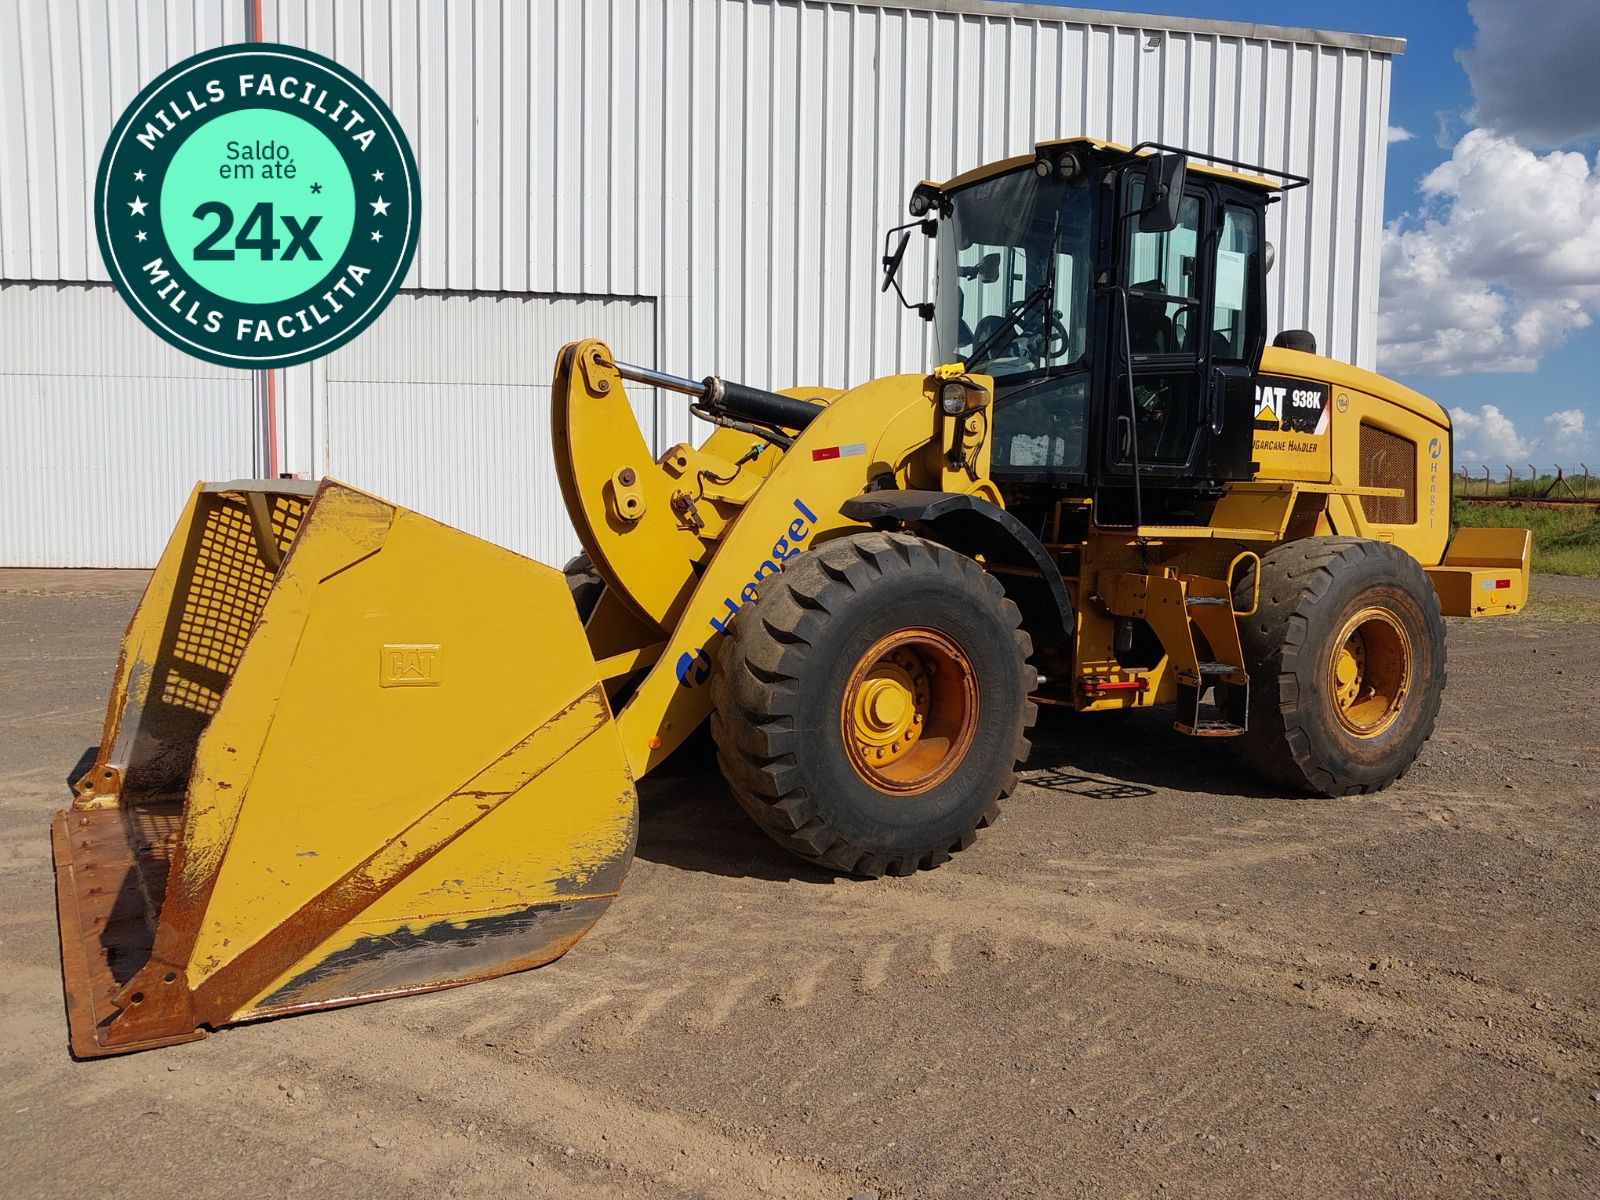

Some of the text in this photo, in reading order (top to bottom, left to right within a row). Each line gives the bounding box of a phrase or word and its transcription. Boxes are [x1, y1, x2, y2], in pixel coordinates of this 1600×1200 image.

[1292, 389, 1322, 410] 938K
[1429, 461, 1438, 529] Hengel
[709, 498, 818, 637] Hengel
[387, 650, 437, 681] CAT
